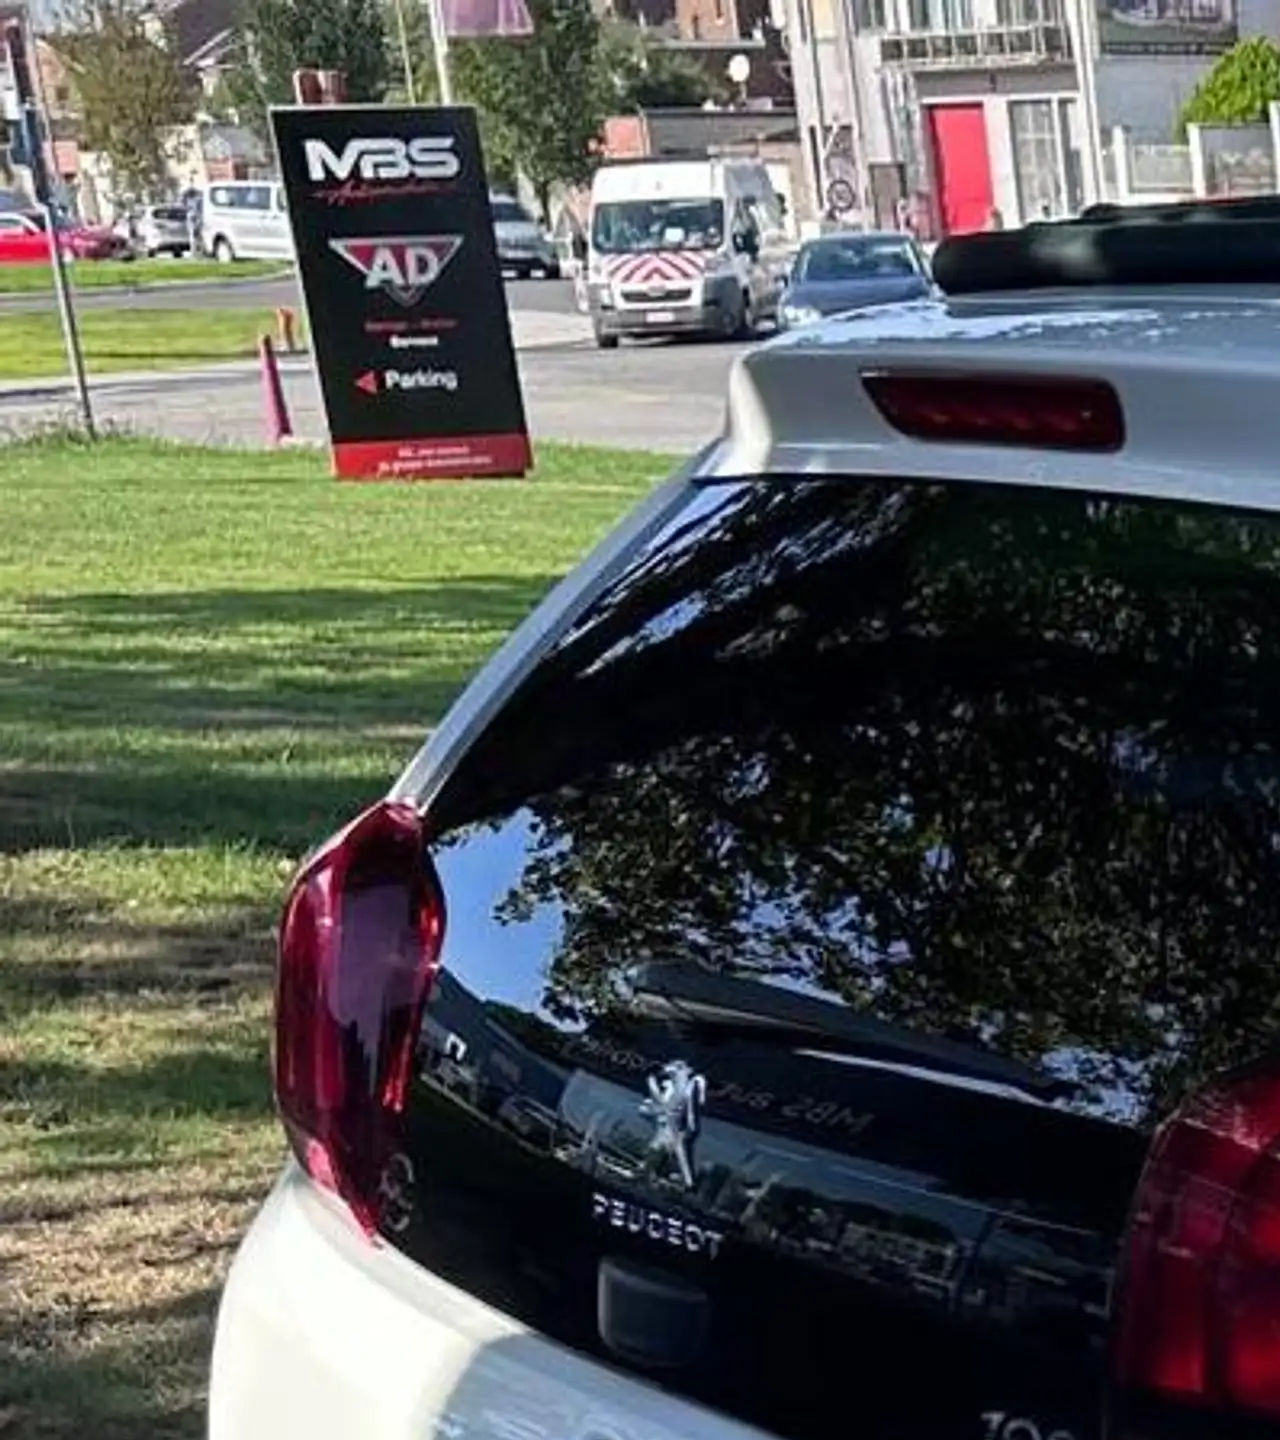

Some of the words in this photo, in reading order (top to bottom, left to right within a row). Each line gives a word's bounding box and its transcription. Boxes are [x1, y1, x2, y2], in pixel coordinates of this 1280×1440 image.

[304, 137, 461, 181] MBS
[364, 247, 441, 289] AD
[385, 367, 458, 390] Parking
[592, 1191, 724, 1261] PEUGEOT
